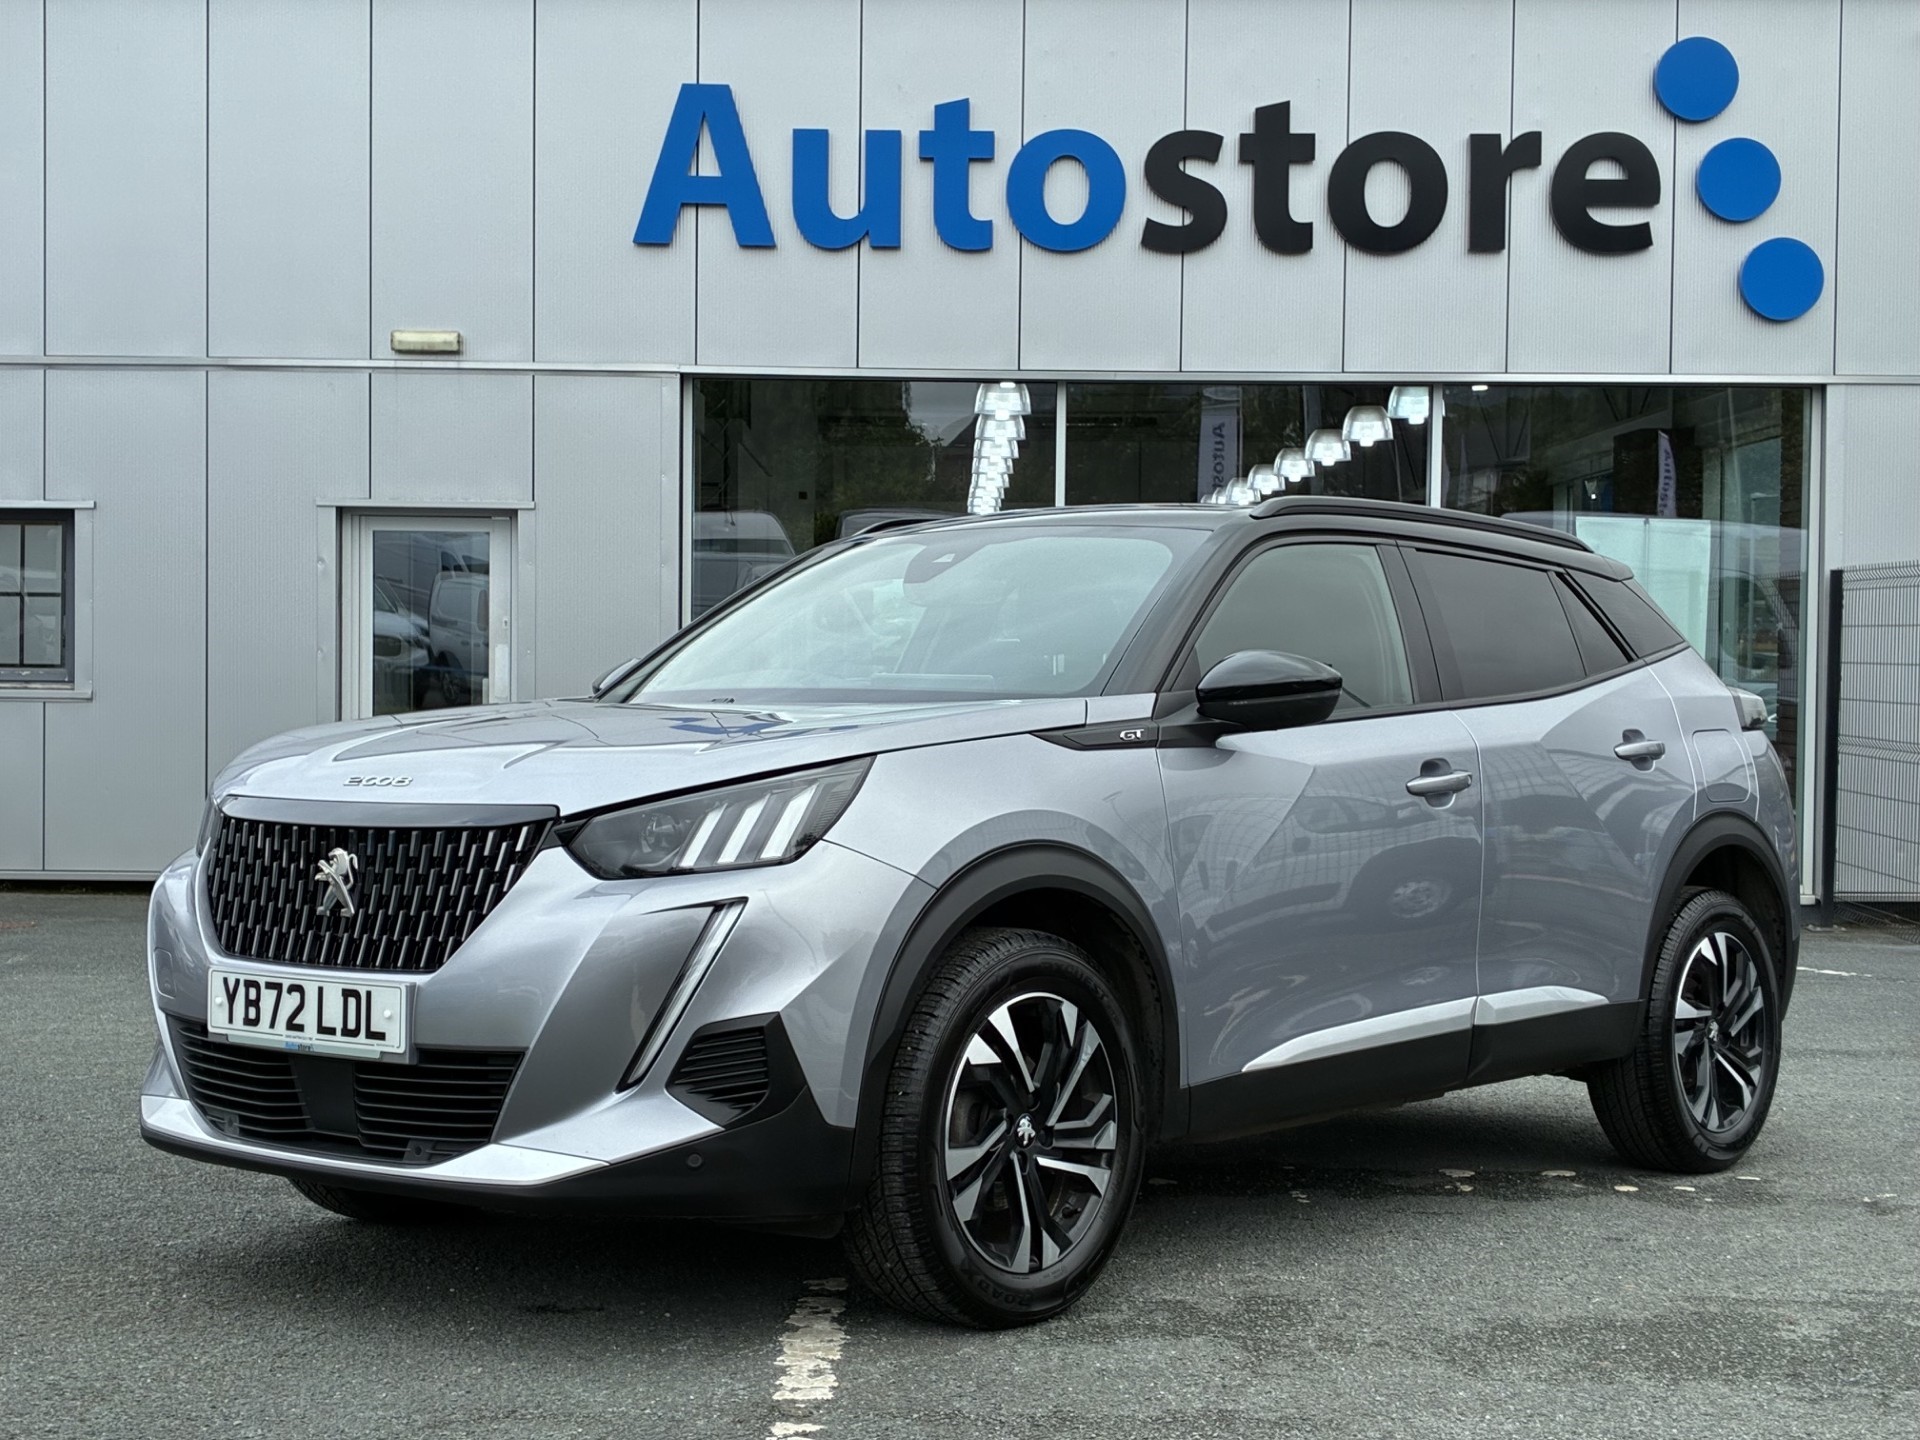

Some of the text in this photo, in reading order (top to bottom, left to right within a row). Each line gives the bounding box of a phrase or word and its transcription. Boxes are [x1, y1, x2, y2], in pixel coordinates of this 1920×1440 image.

[633, 82, 1660, 256] Autostore
[1119, 728, 1145, 741] GT
[343, 774, 414, 788] 2008
[223, 977, 386, 1041] YB72 LDL
